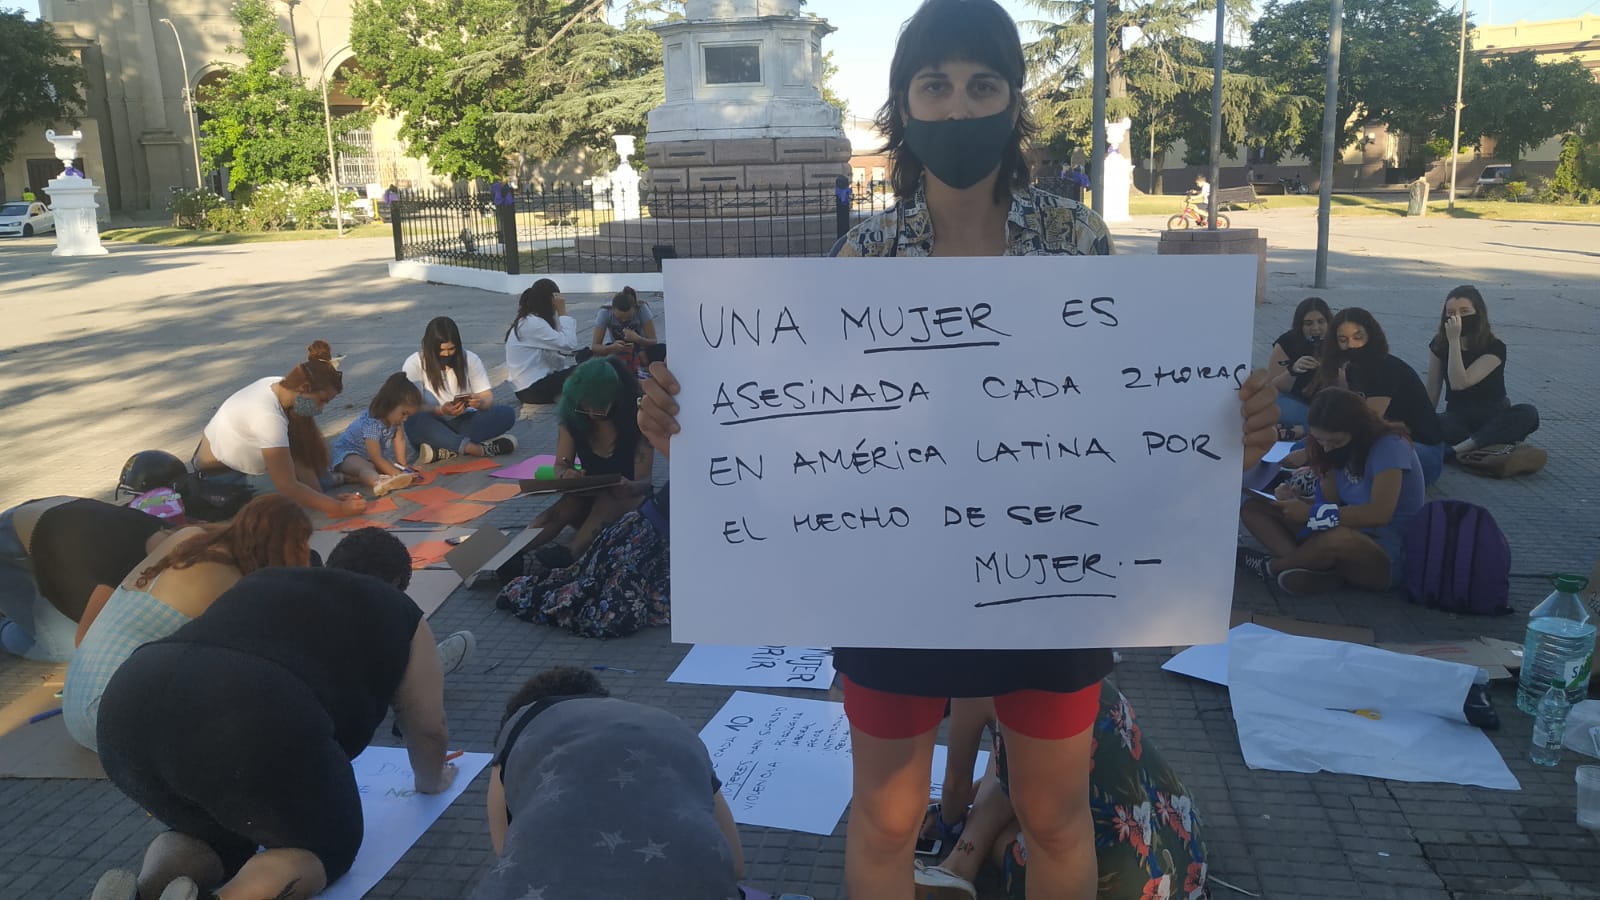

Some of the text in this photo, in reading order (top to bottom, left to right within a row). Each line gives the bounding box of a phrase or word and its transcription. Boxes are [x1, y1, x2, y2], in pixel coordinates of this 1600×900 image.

[700, 297, 1118, 348] UNA MUJER ES
[983, 376, 1080, 400] CADA
[1121, 367, 1151, 392] 2
[710, 455, 762, 486] EN
[1142, 431, 1221, 460] POR
[723, 505, 1099, 544] EL HECHO DE SER
[723, 715, 754, 732] 10
